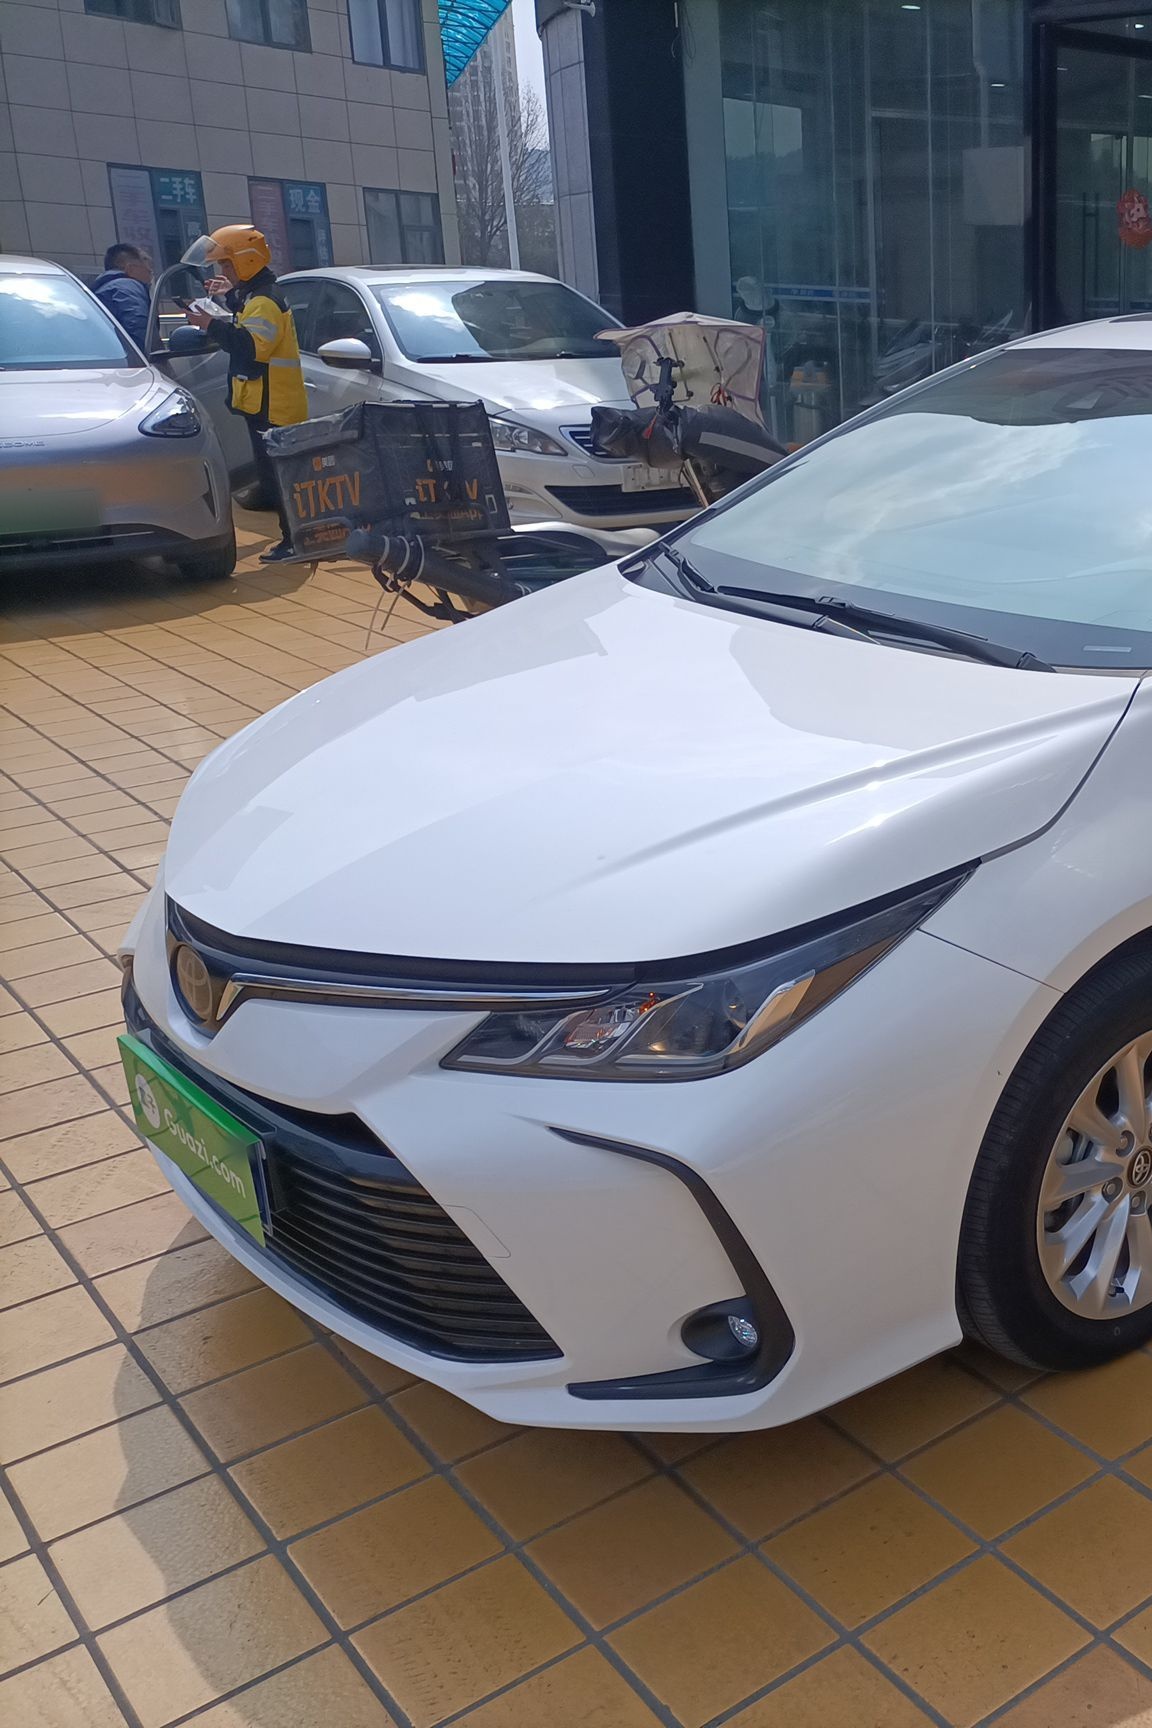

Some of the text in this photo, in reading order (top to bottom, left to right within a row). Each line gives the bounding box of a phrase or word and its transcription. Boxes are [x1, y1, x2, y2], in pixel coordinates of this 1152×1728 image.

[160, 177, 197, 204] 二手车
[288, 188, 321, 214] 现金
[293, 471, 361, 519] iTKTV
[163, 1108, 246, 1198] Guazi.com
